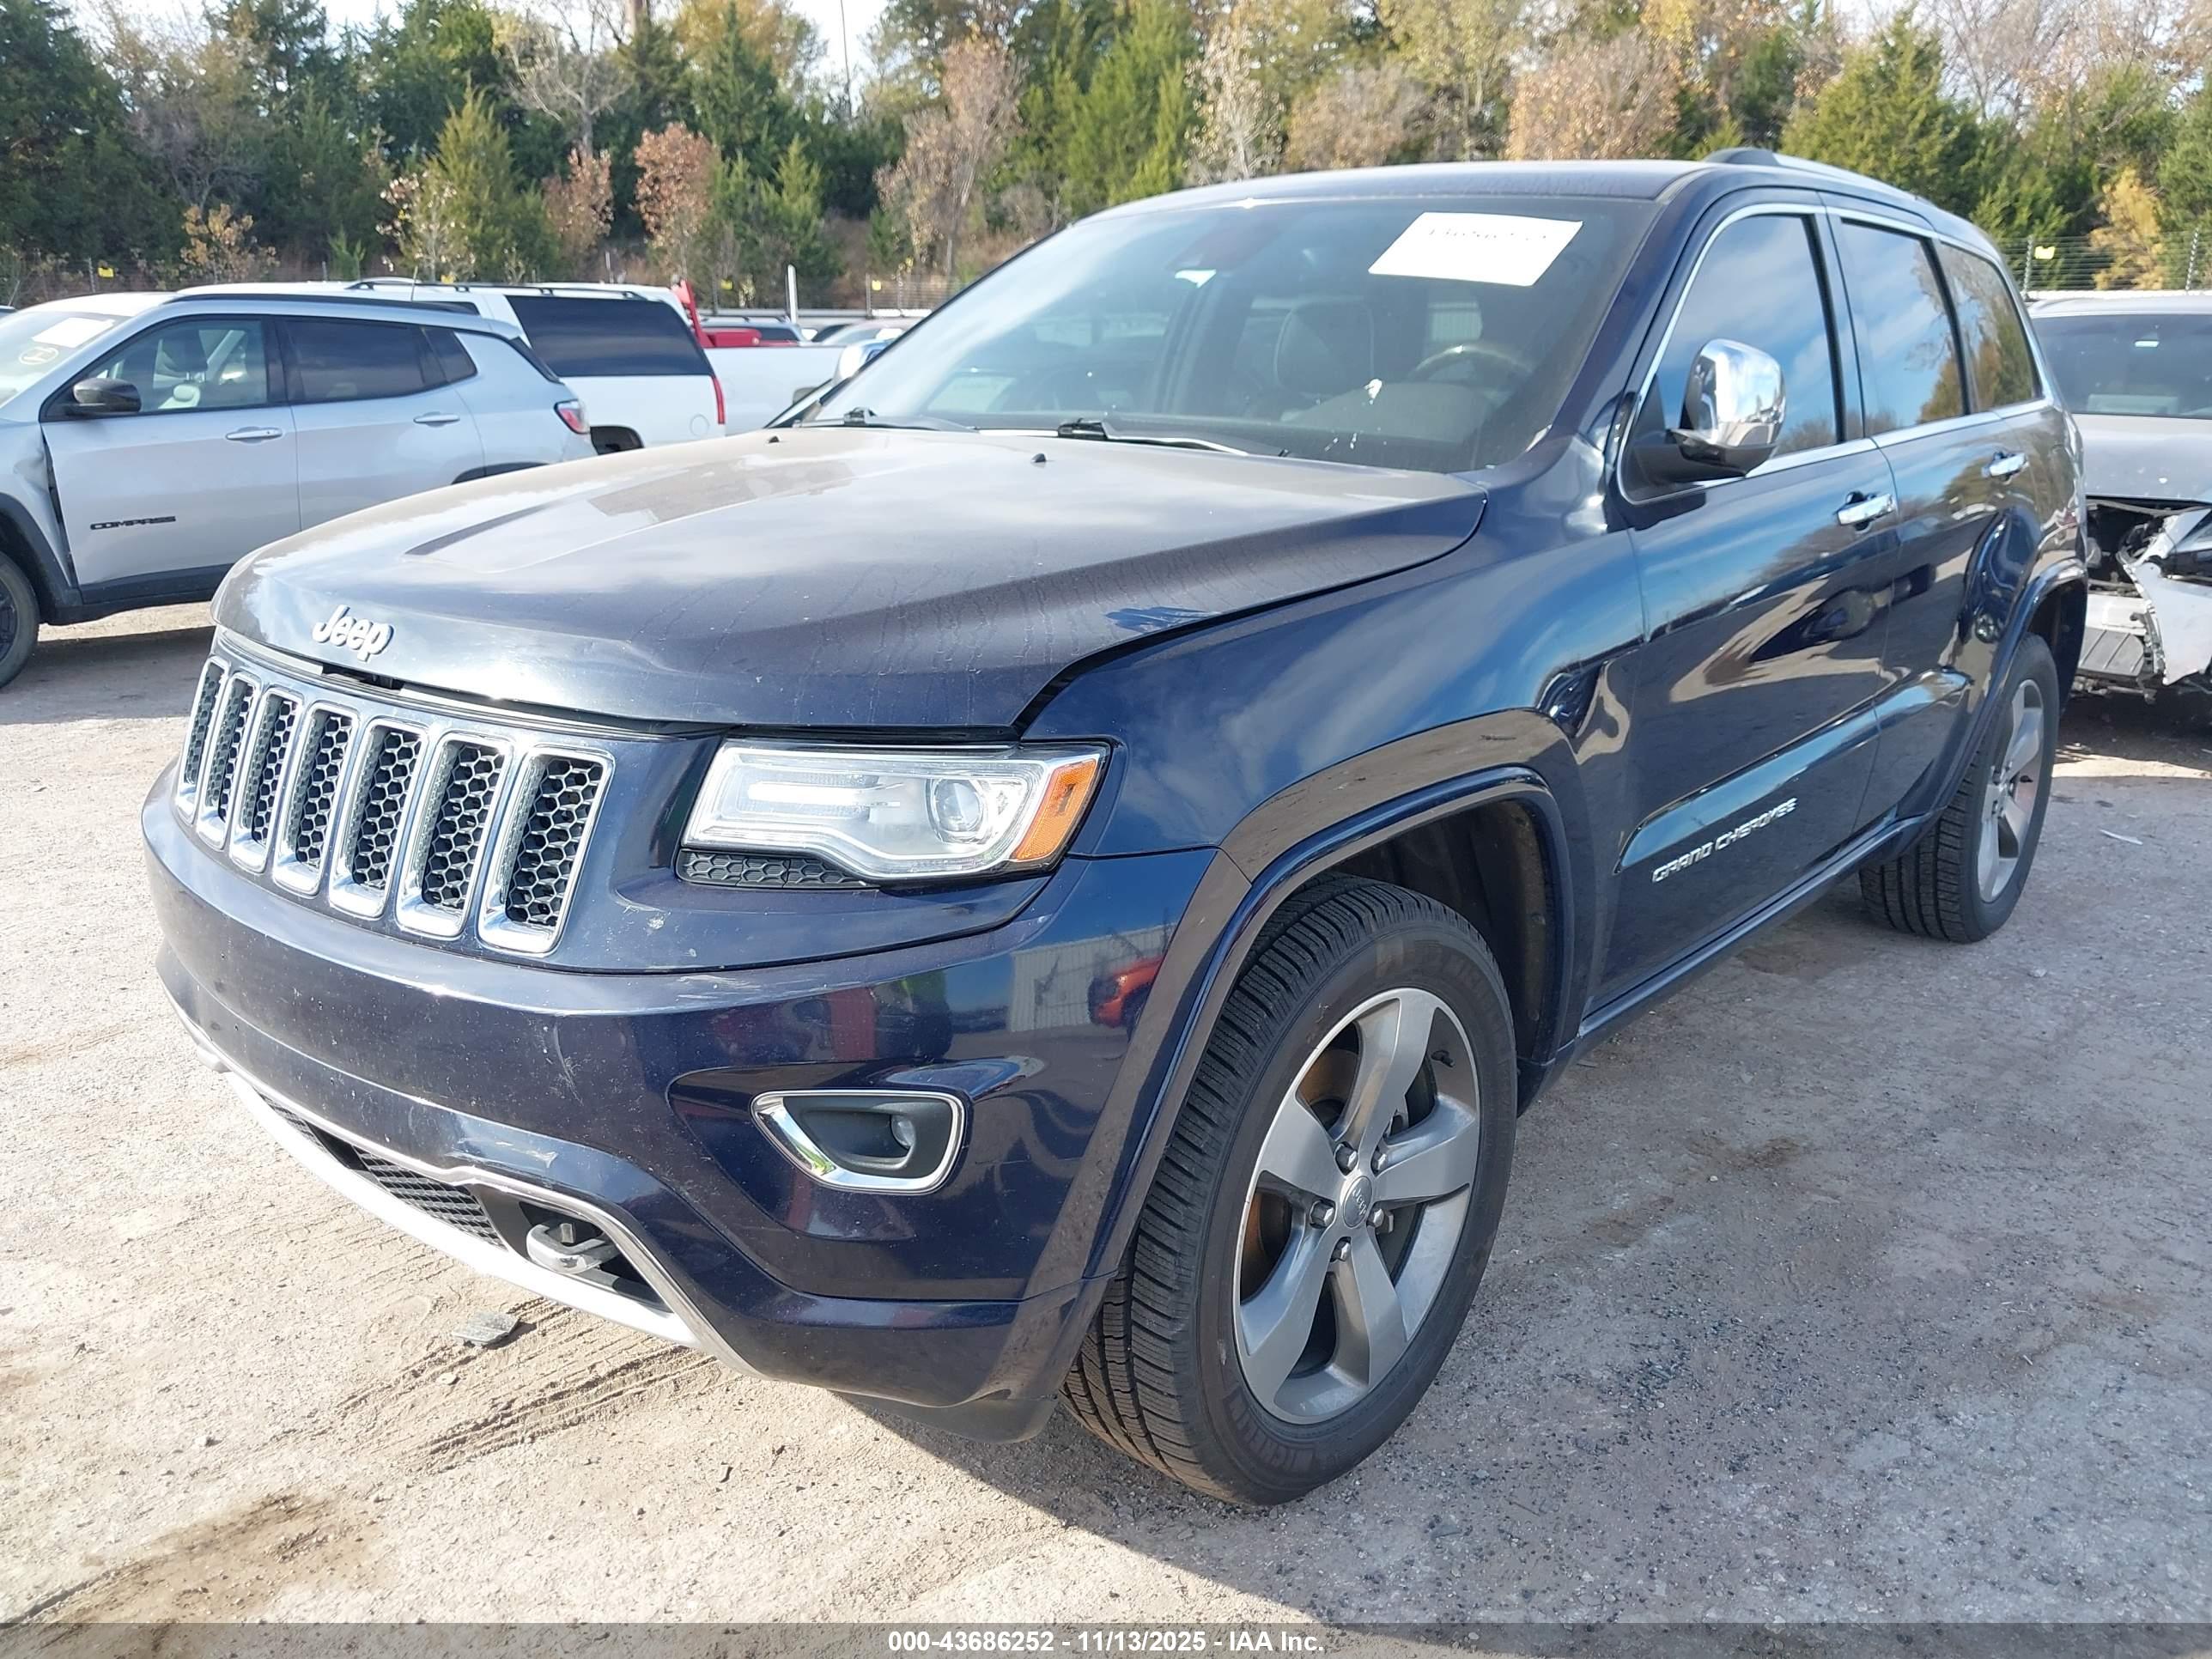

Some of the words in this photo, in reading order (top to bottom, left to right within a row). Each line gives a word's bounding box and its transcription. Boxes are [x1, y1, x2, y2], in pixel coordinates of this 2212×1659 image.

[89, 515, 177, 531] COMPASS
[312, 604, 394, 662] Jeep
[1651, 841, 1714, 884] GRAND
[1714, 797, 1798, 852] CHEROKEE
[1352, 1188, 1368, 1217] Jeep
